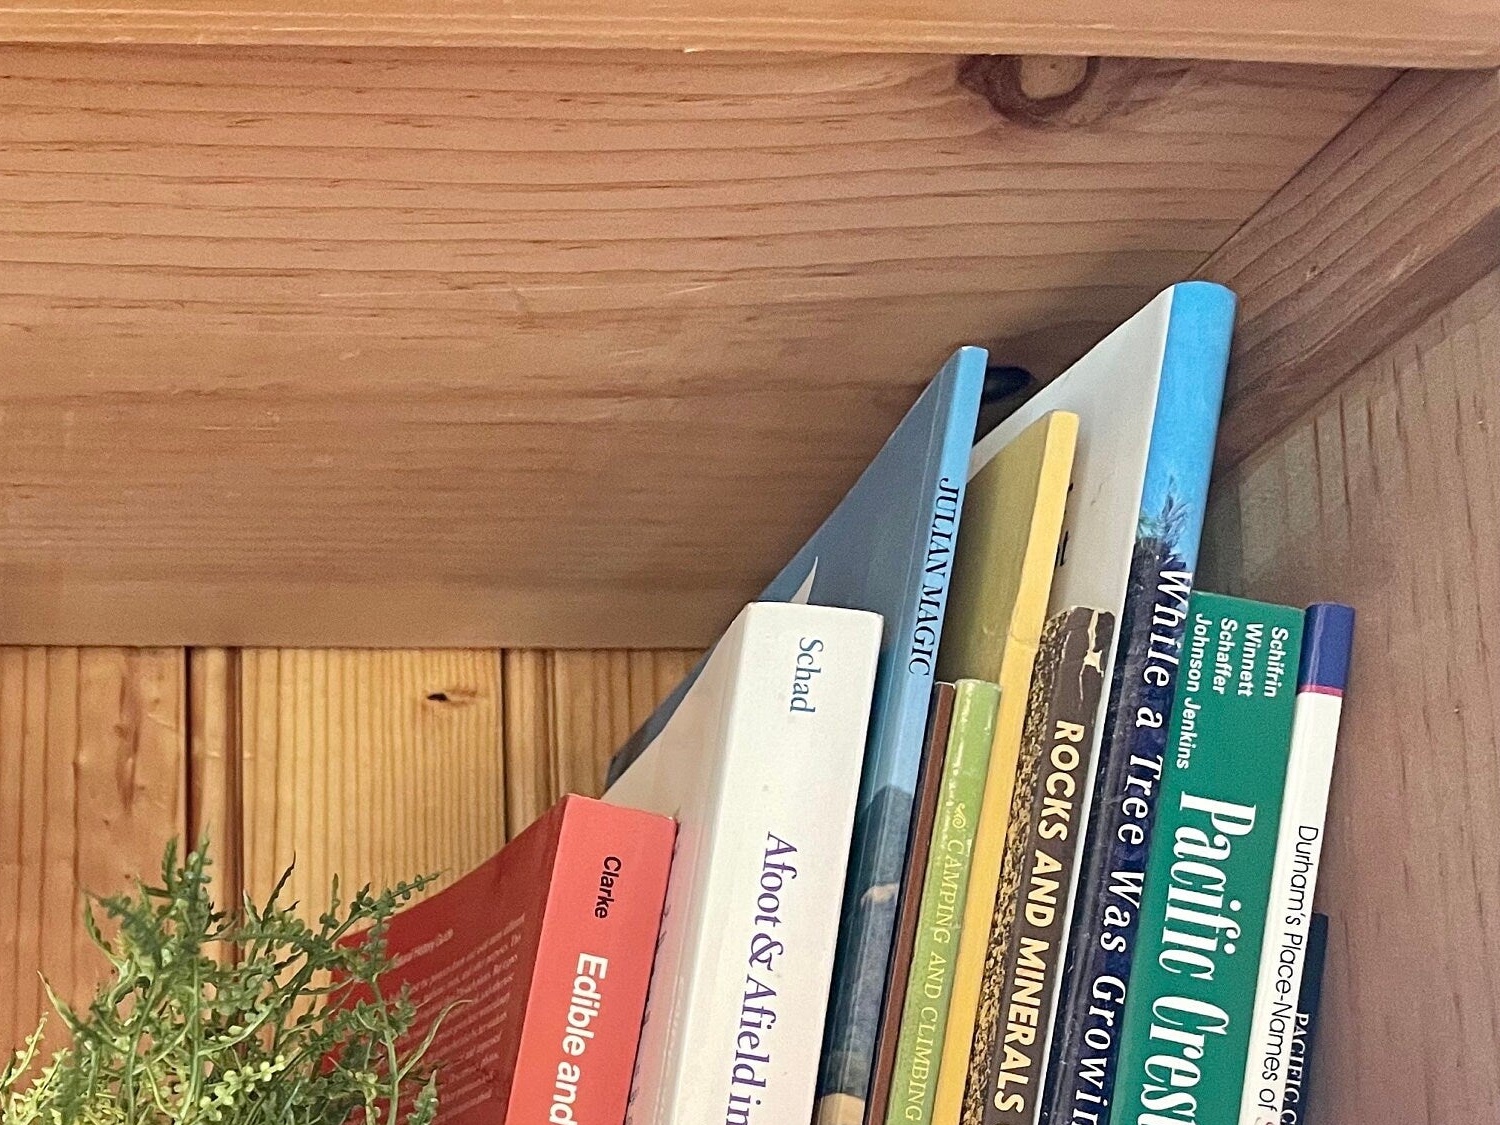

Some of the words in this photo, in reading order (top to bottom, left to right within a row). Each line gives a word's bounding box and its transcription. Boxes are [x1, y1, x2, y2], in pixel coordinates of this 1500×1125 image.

[926, 478, 959, 577] JULIAN
[909, 586, 940, 676] MAGIC
[1144, 570, 1194, 686] While
[1187, 614, 1212, 692] Johnson
[1213, 618, 1237, 694] Schaffer
[1238, 624, 1263, 696] Winnett
[1264, 627, 1288, 697] Schifrin
[790, 638, 823, 712] Schad
[1136, 707, 1162, 727] a
[1177, 698, 1201, 769] Jenkins
[1039, 721, 1084, 840] ROCKS
[1118, 755, 1163, 844] Tree
[595, 857, 621, 918] Clarke
[755, 832, 797, 927] Afoot
[933, 839, 969, 943] CAMPING
[1026, 850, 1062, 926] AND
[1101, 872, 1144, 952] Was
[1159, 791, 1256, 980] Pacific
[749, 933, 783, 971] &
[925, 951, 946, 998] AND
[563, 953, 608, 1055] Edible
[732, 974, 776, 1087] Afield
[994, 937, 1049, 1112] MINERALS
[1262, 933, 1303, 1081] Place-Names
[906, 1007, 937, 1120] CLIMBING
[1258, 1089, 1277, 1111] of
[1284, 1013, 1309, 1103] PACIFIC
